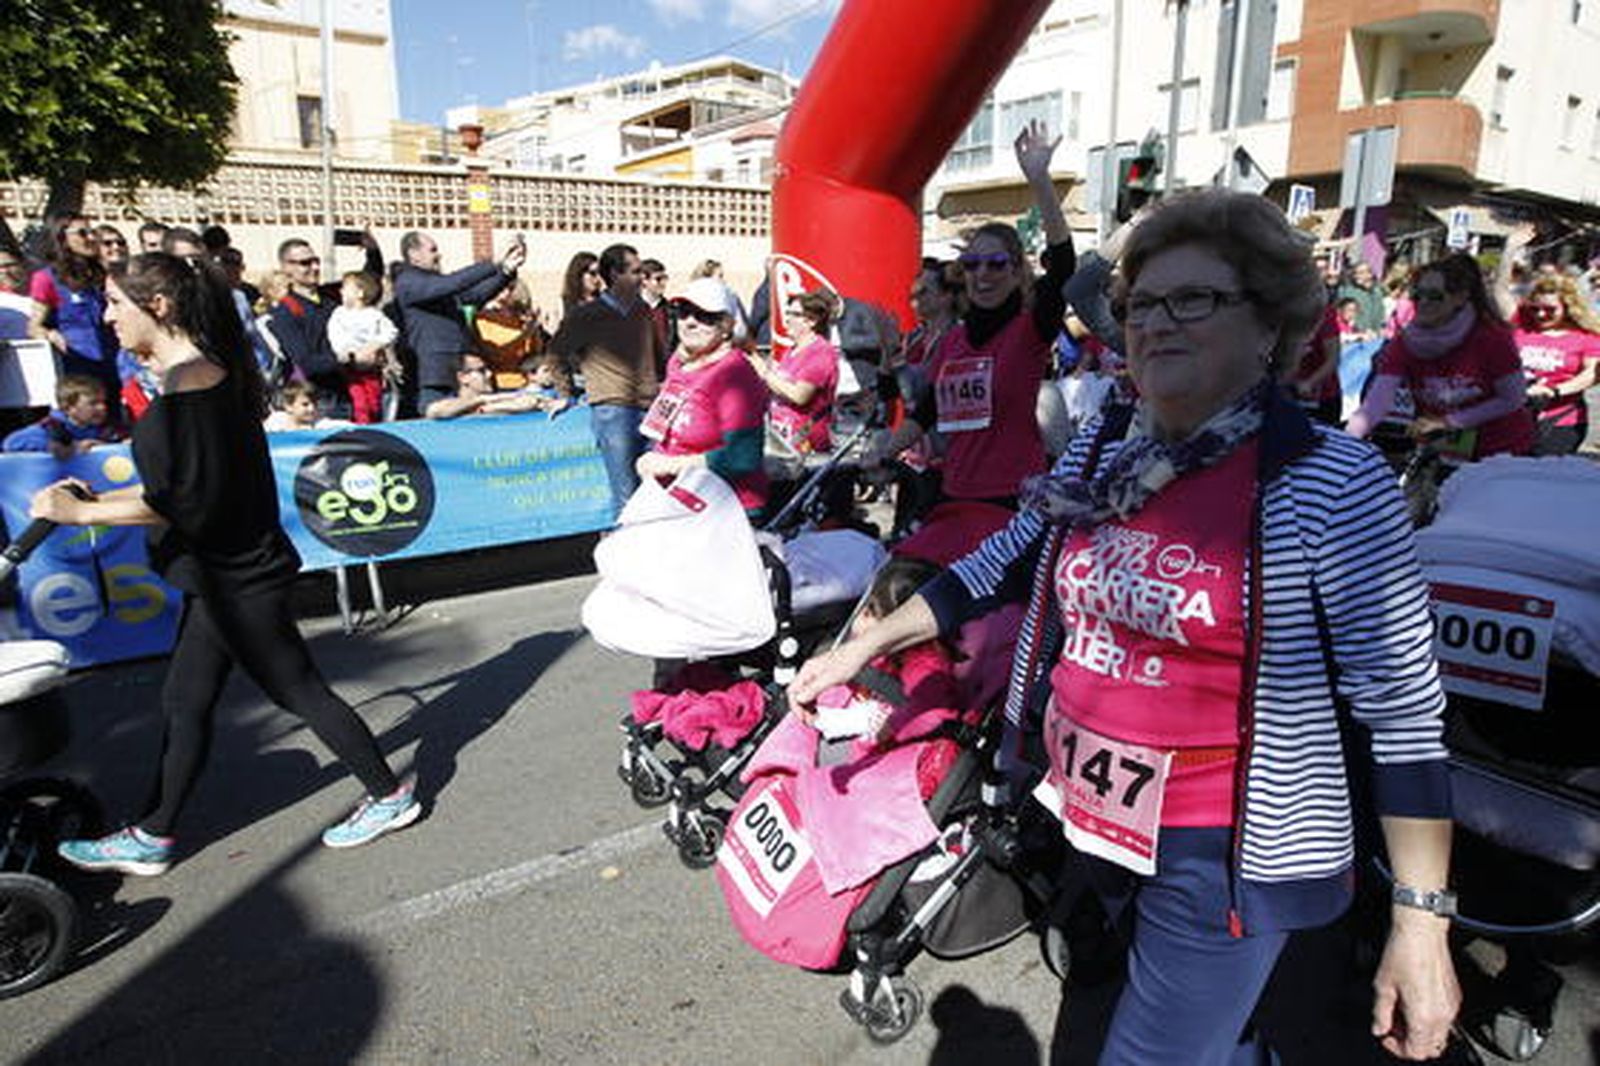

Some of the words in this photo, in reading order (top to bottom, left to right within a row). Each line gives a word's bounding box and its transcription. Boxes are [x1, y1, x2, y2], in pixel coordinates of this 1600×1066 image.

[1066, 556, 1216, 627] CARRERA
[1430, 609, 1536, 661] 000
[744, 802, 797, 873] 0000
